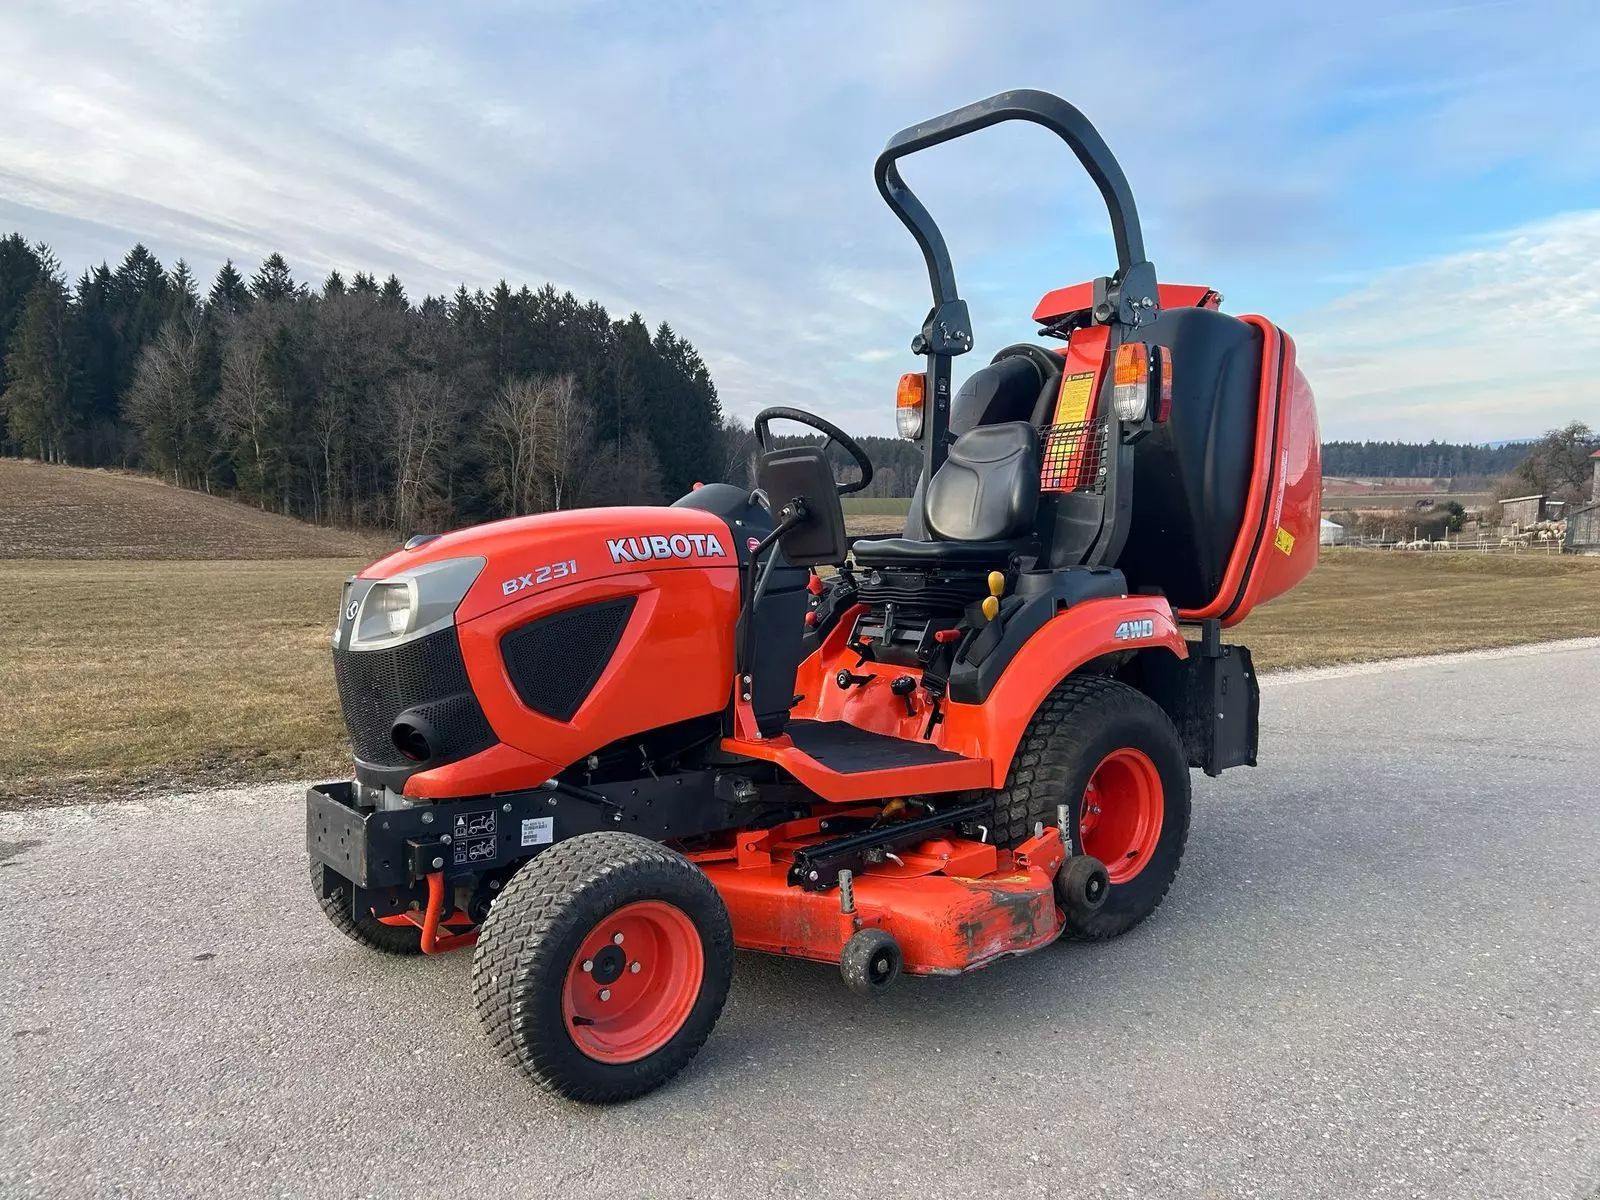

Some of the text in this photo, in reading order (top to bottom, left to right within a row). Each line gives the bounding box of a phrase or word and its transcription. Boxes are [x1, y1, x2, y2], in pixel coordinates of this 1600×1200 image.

[606, 534, 727, 564] KUBOTA
[502, 560, 577, 595] BX231
[1115, 619, 1153, 640] 4WD
